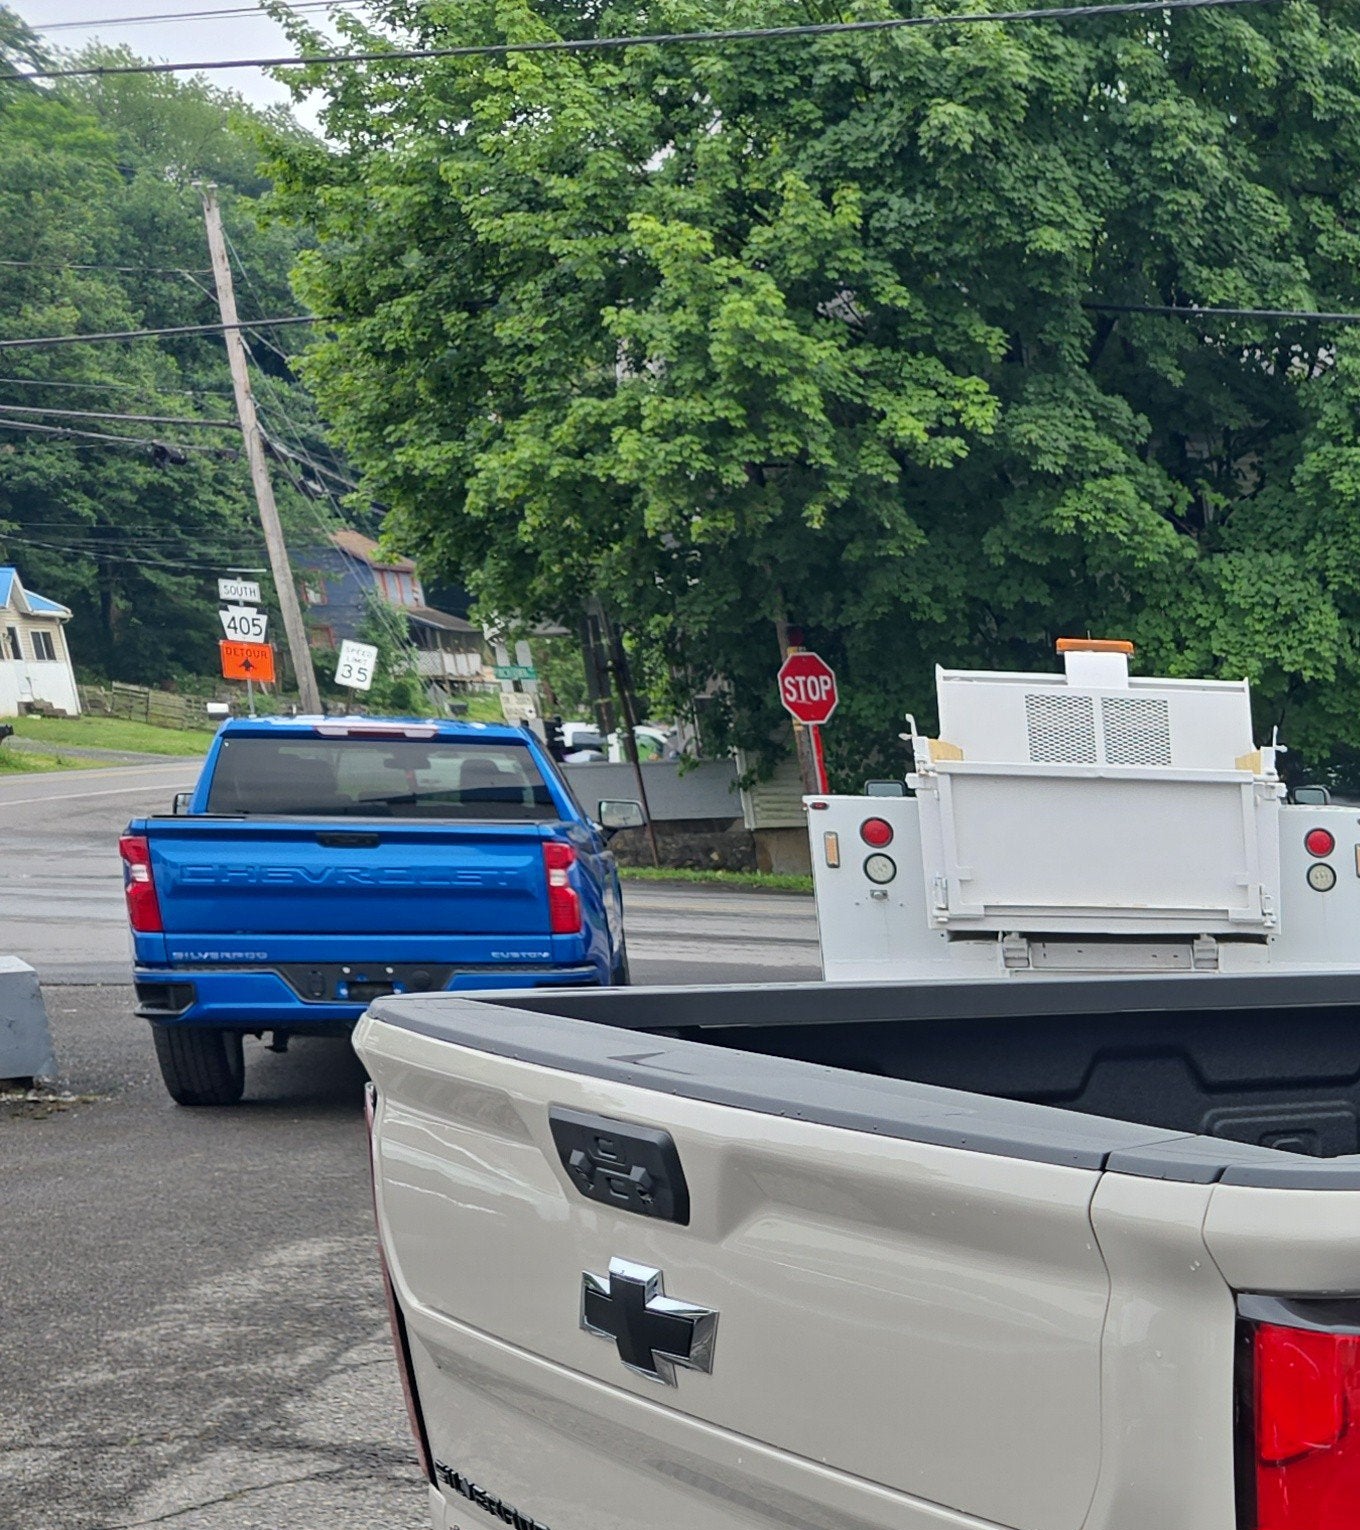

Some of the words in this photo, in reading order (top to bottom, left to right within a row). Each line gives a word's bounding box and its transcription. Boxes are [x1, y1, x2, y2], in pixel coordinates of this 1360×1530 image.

[223, 585, 256, 597] SOUTH
[227, 616, 262, 637] 405
[225, 647, 268, 659] DETOUR
[341, 664, 368, 683] 35
[784, 675, 832, 702] STOP
[179, 864, 520, 887] CHEVROLET
[172, 950, 268, 960] SILVERADO
[490, 949, 550, 959] CUSTOM
